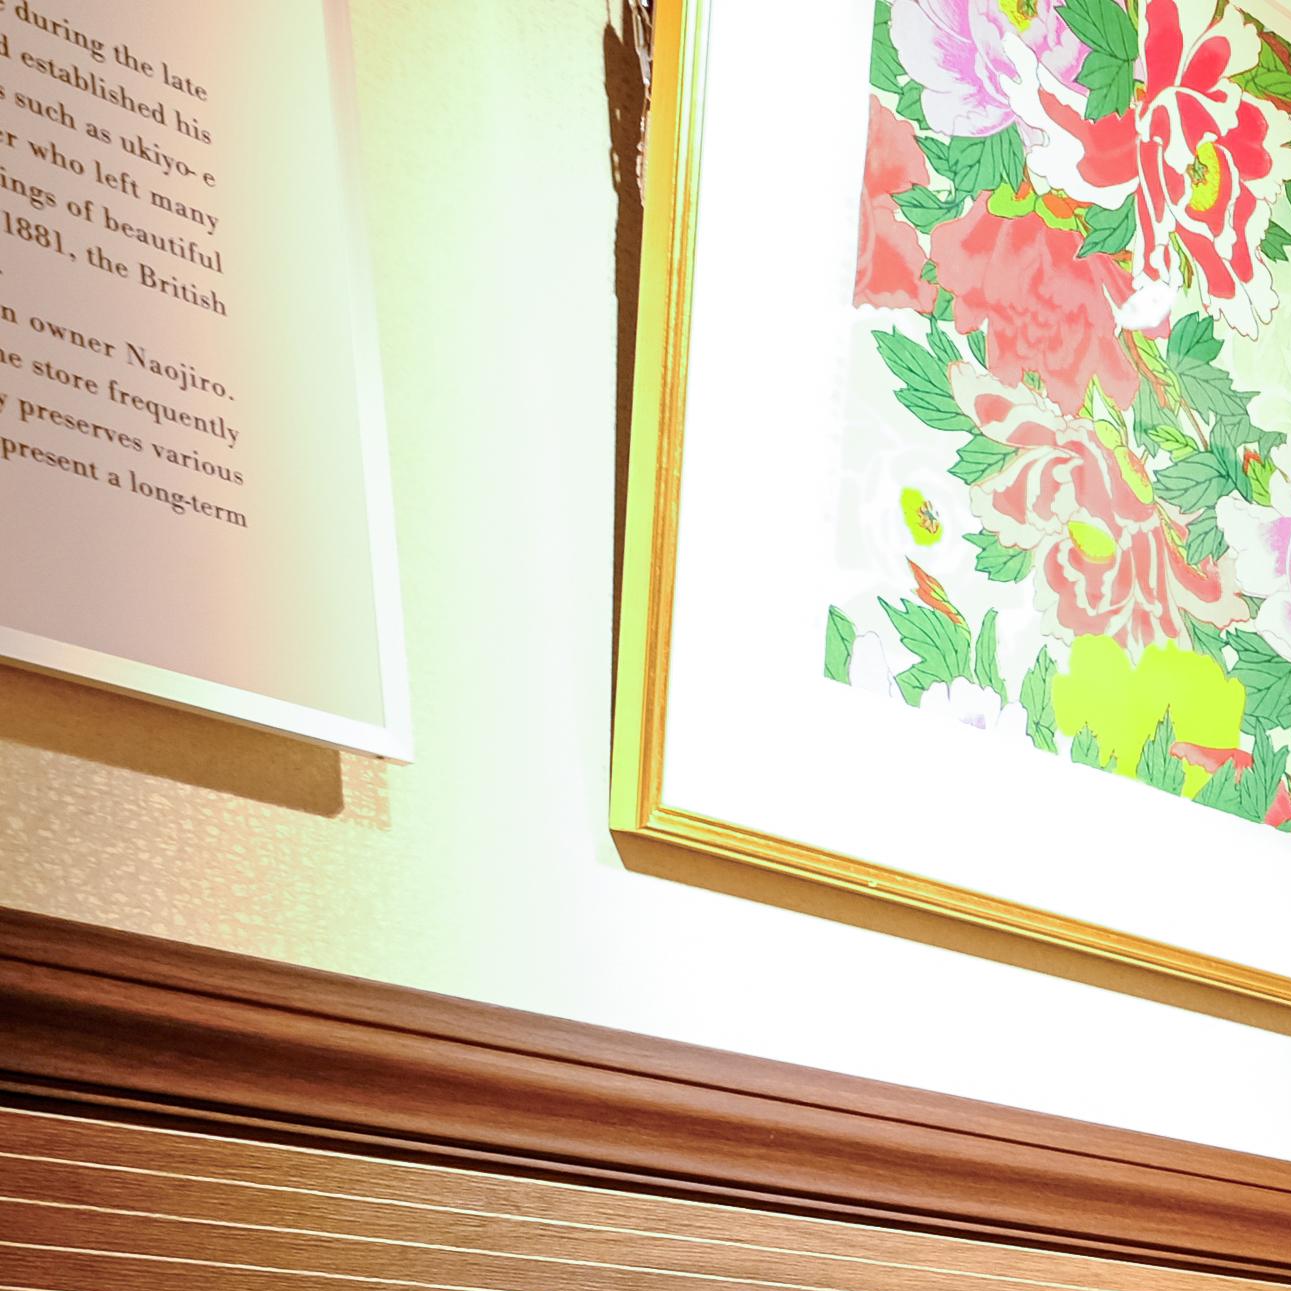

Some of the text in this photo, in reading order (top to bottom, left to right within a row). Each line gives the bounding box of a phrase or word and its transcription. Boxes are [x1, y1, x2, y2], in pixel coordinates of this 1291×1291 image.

[15, 1, 206, 100] during the late
[15, 93, 76, 129] such
[85, 123, 111, 143] as
[20, 52, 211, 144] established his
[27, 140, 217, 235] who left many
[2, 211, 225, 315] 1881, the British
[66, 200, 93, 221] of
[103, 206, 222, 273] beautiful
[29, 317, 233, 400] owner Naojiro.
[18, 399, 243, 483] preserves various
[32, 360, 238, 449] store frequently
[2, 438, 246, 527] present a long-term
